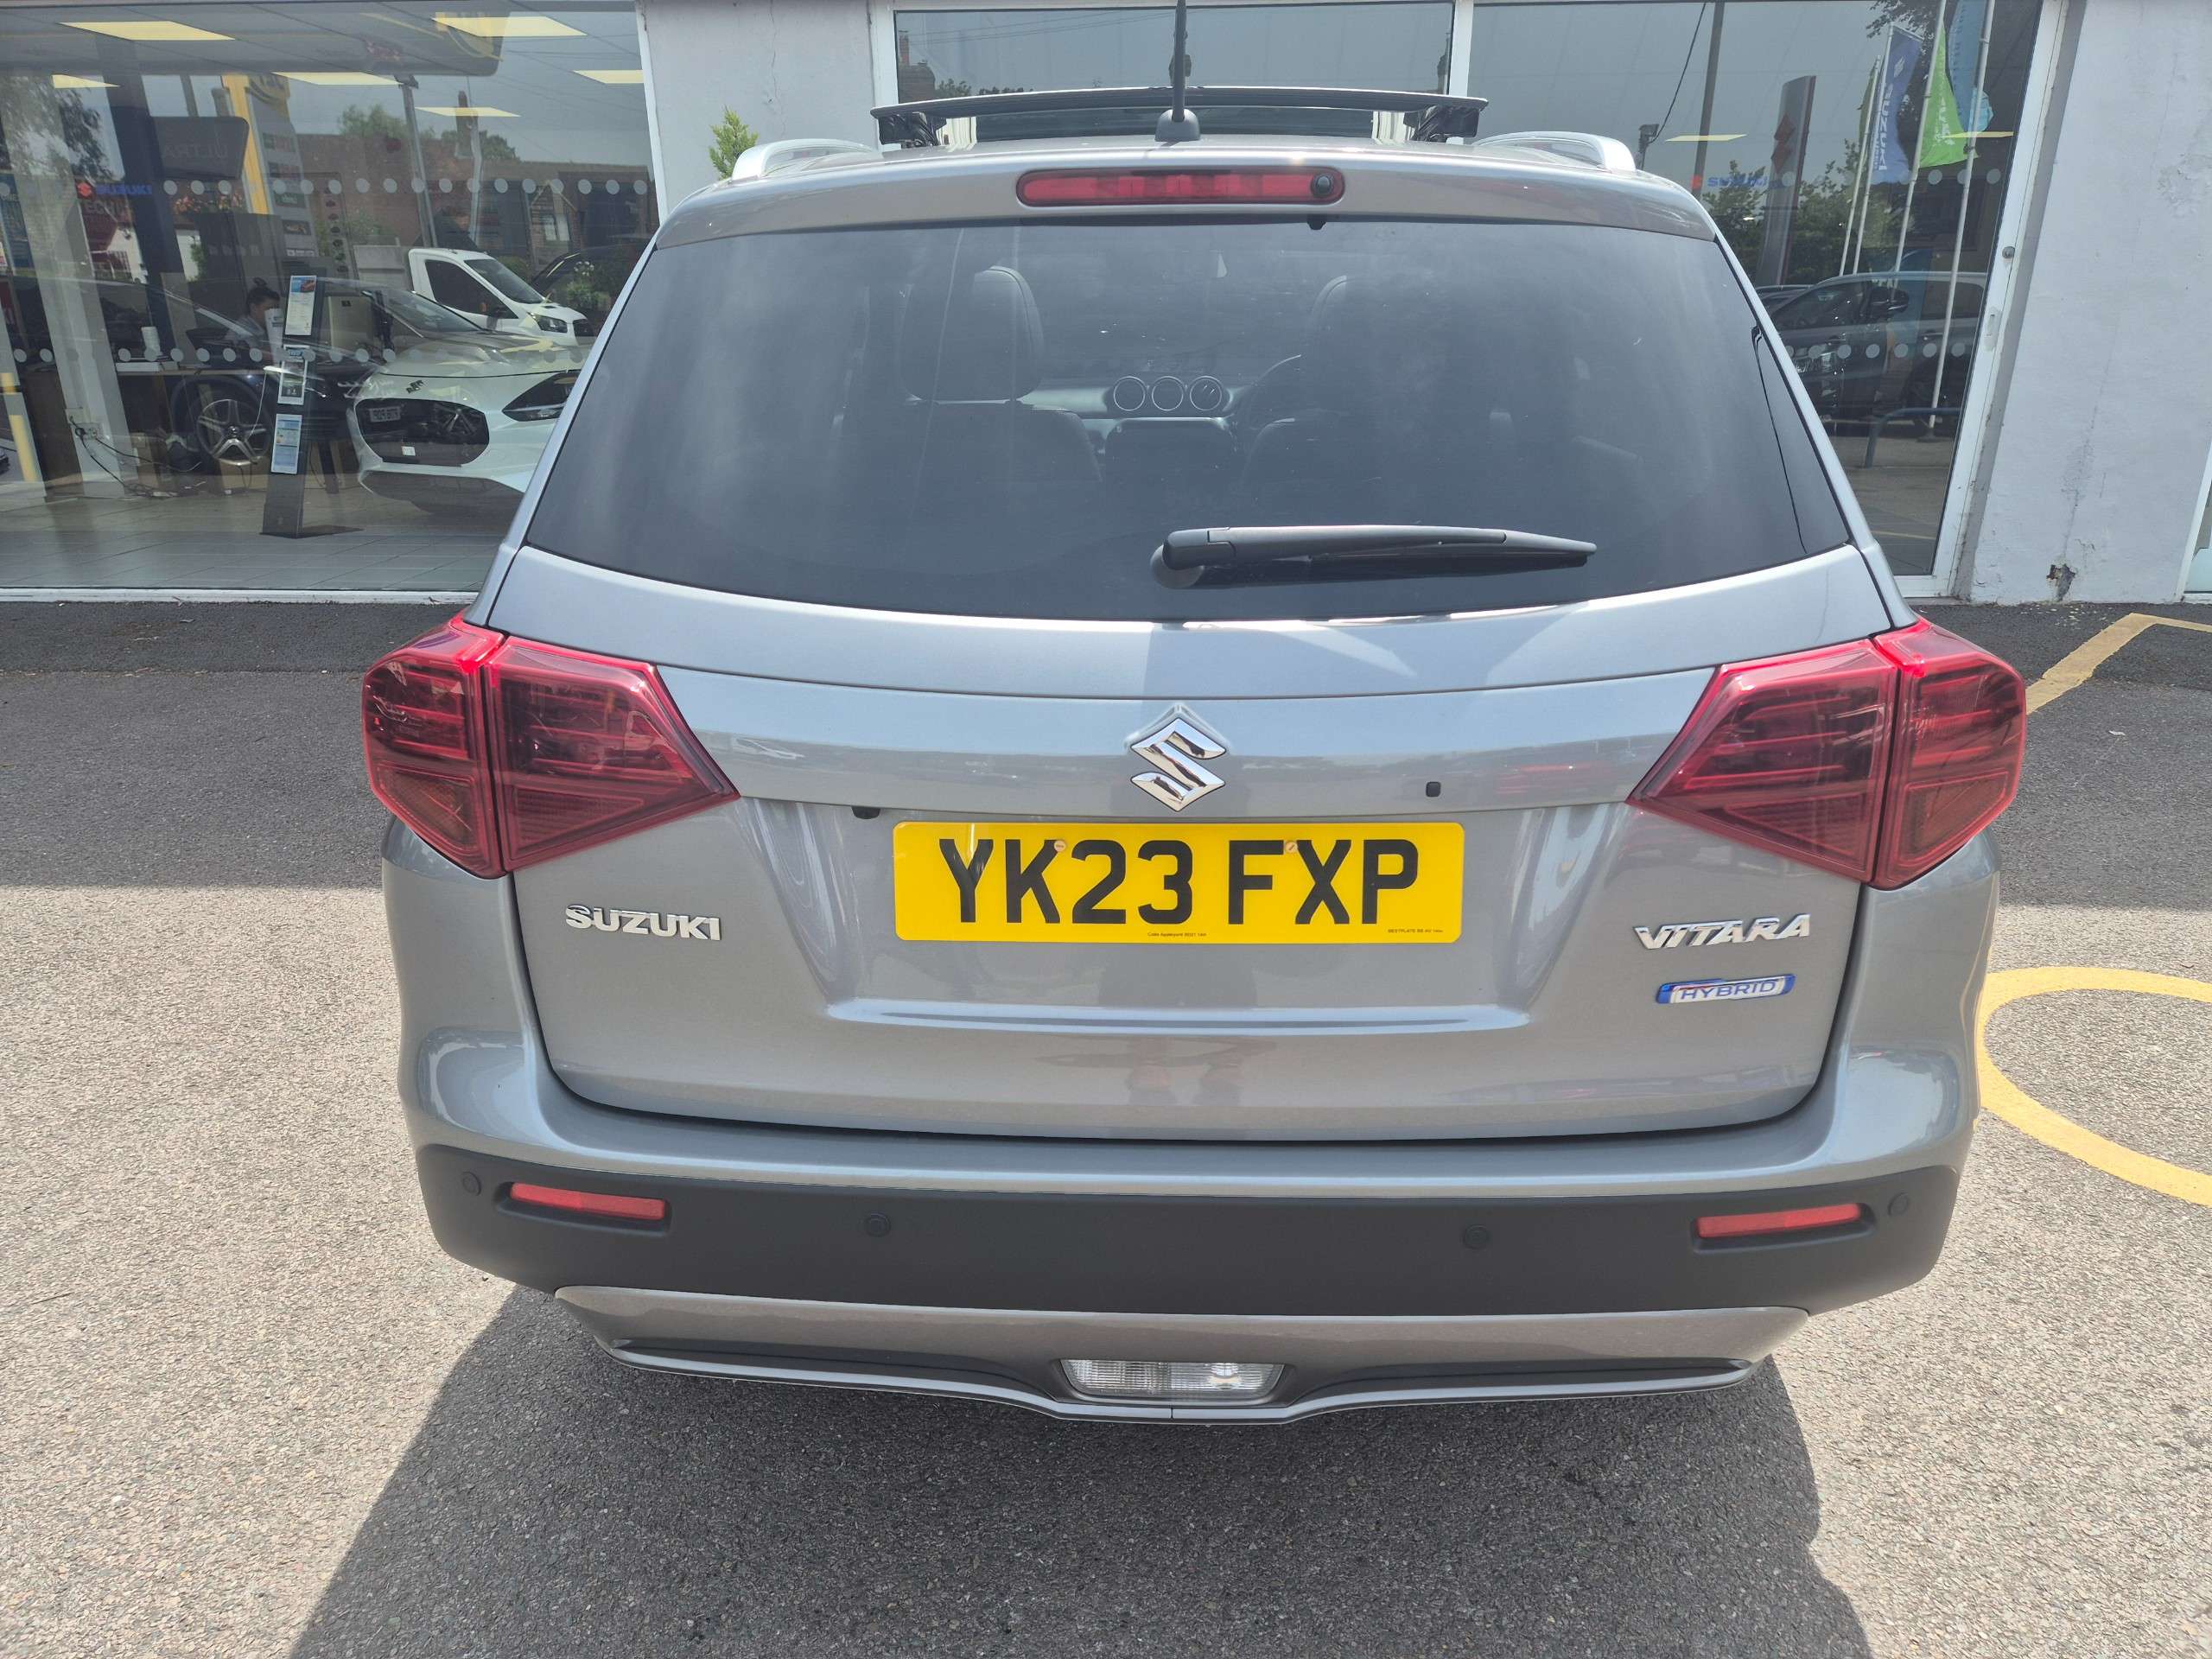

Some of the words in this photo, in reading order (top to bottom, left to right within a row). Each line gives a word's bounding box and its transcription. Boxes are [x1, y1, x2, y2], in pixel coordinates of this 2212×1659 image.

[1878, 83, 1893, 170] SUZUKI
[938, 838, 1193, 925] YK23
[1228, 838, 1419, 925] FXP
[564, 904, 721, 941] SUZUKI
[1634, 913, 1810, 950] VITARA
[1681, 980, 1778, 1000] HYBRID
